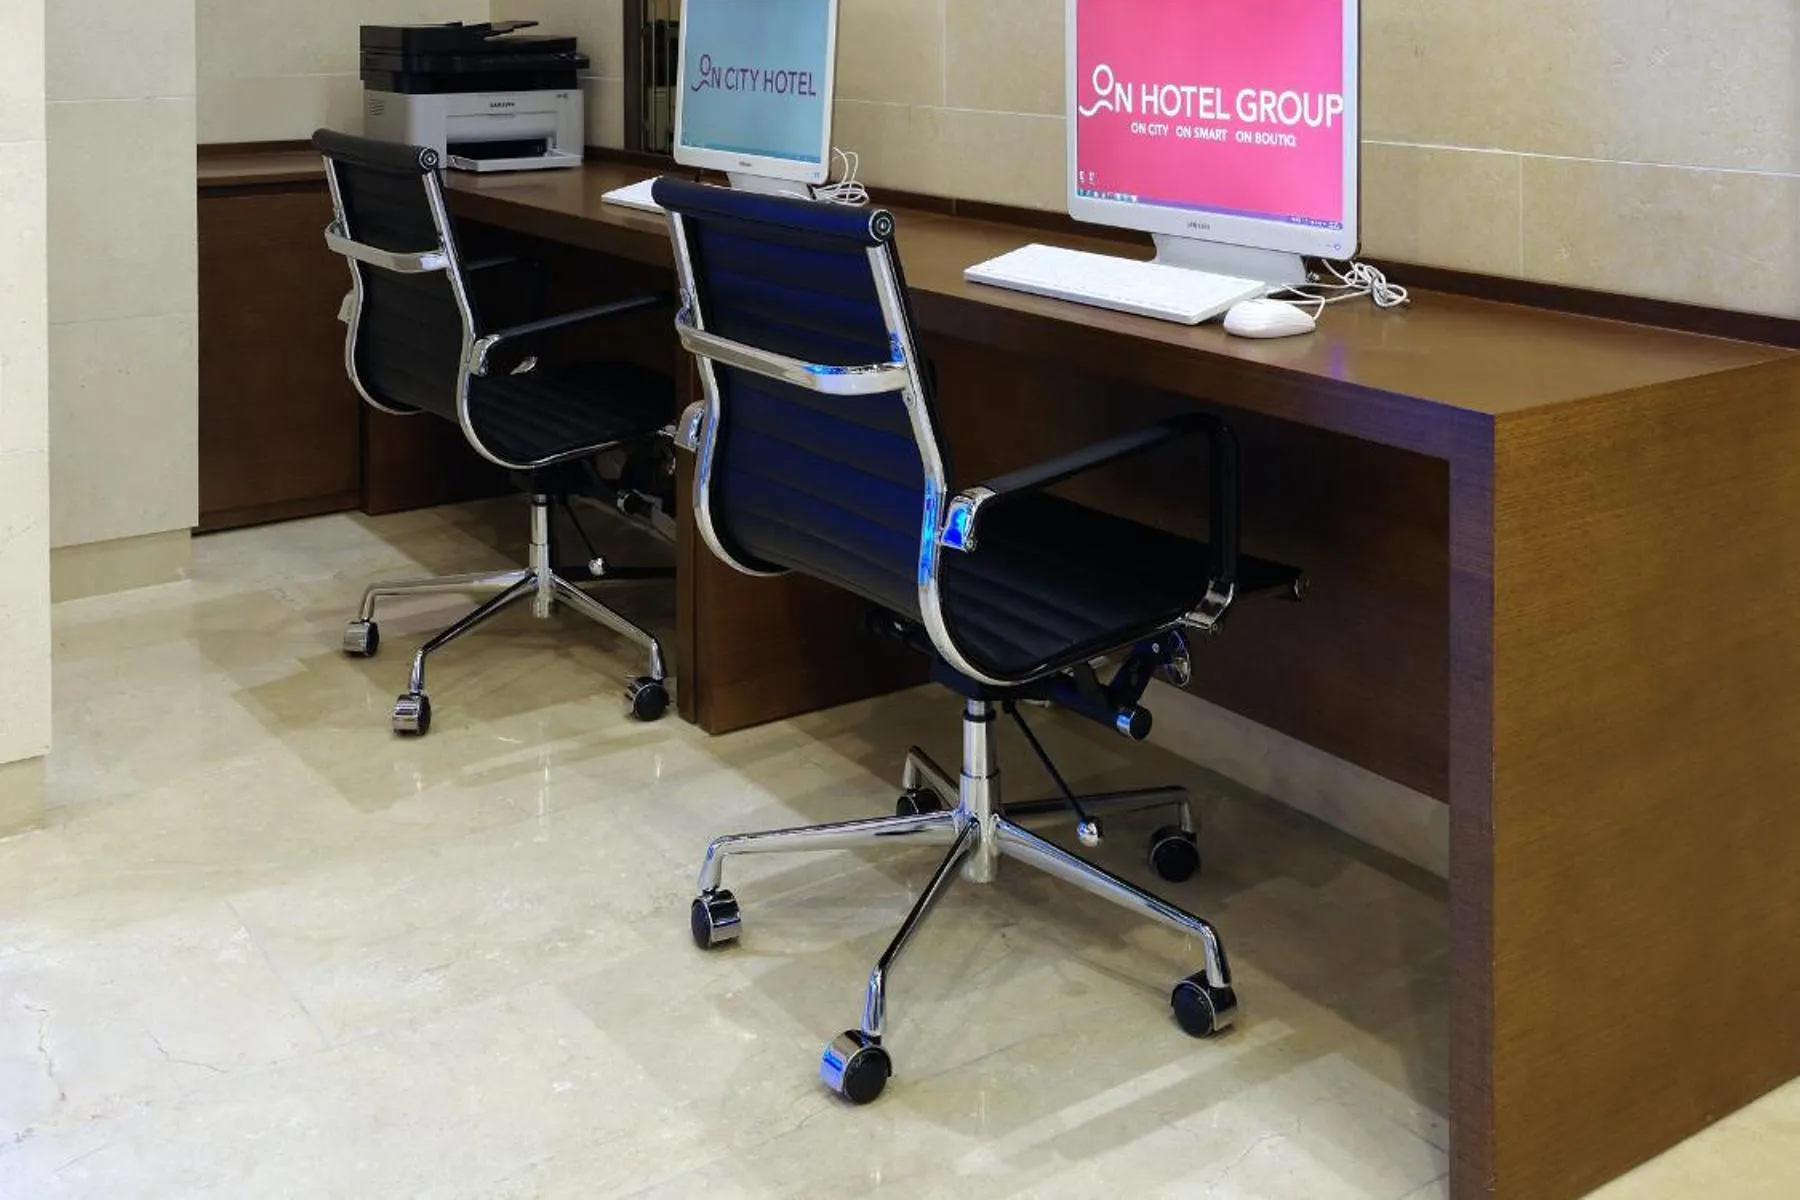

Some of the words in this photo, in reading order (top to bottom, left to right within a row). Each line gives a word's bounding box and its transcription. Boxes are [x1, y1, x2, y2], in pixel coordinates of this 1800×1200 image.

[699, 53, 721, 90] ON
[724, 66, 760, 92] CITY
[763, 70, 816, 96] HOTEL
[1092, 64, 1133, 114] ON
[1140, 83, 1231, 120] HOTEL
[1235, 88, 1344, 128] GROUP
[1130, 122, 1146, 134] ON
[1148, 123, 1169, 136] CITY
[1175, 126, 1191, 139] ON
[1193, 127, 1228, 142] SMART
[1235, 130, 1252, 143] ON
